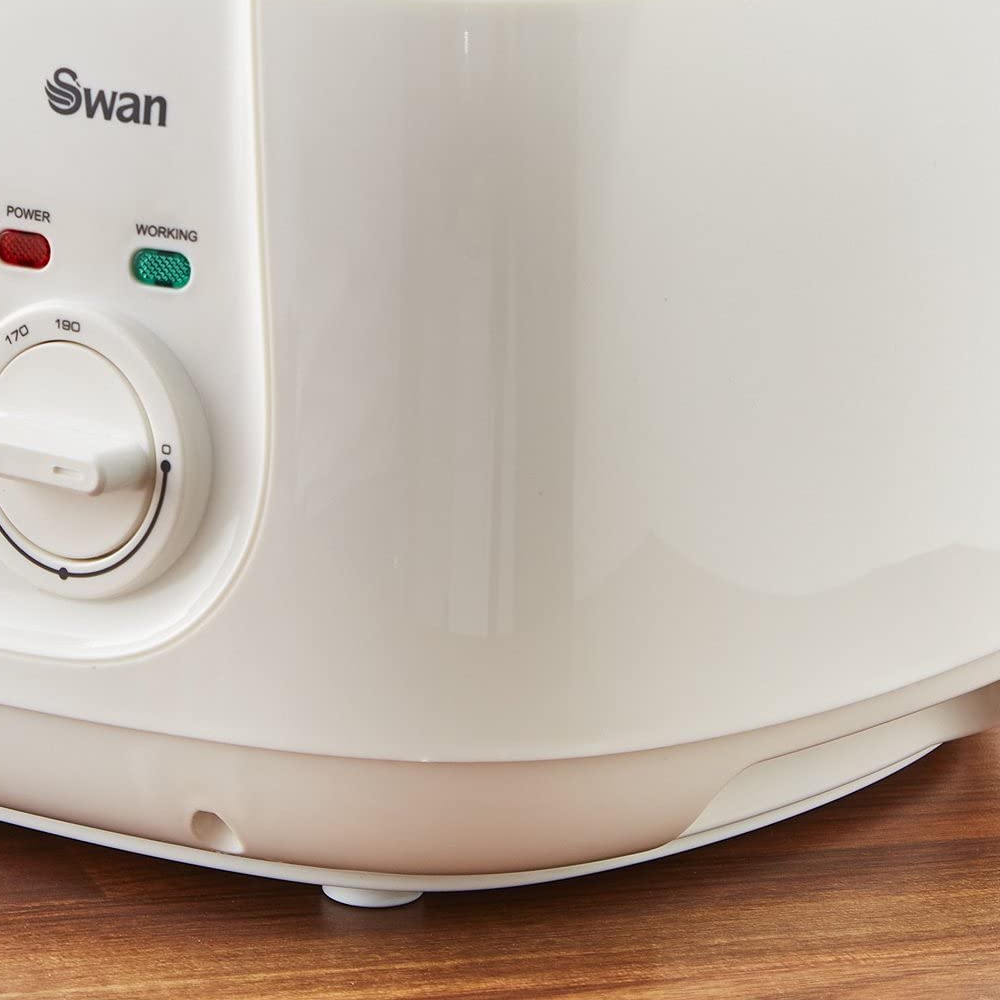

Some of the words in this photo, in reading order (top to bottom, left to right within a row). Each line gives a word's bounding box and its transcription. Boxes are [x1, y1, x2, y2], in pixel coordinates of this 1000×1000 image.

[44, 67, 167, 127] Swan
[6, 205, 51, 223] POWER
[135, 223, 198, 242] WORKING
[5, 324, 30, 346] 170
[55, 318, 81, 333] 190
